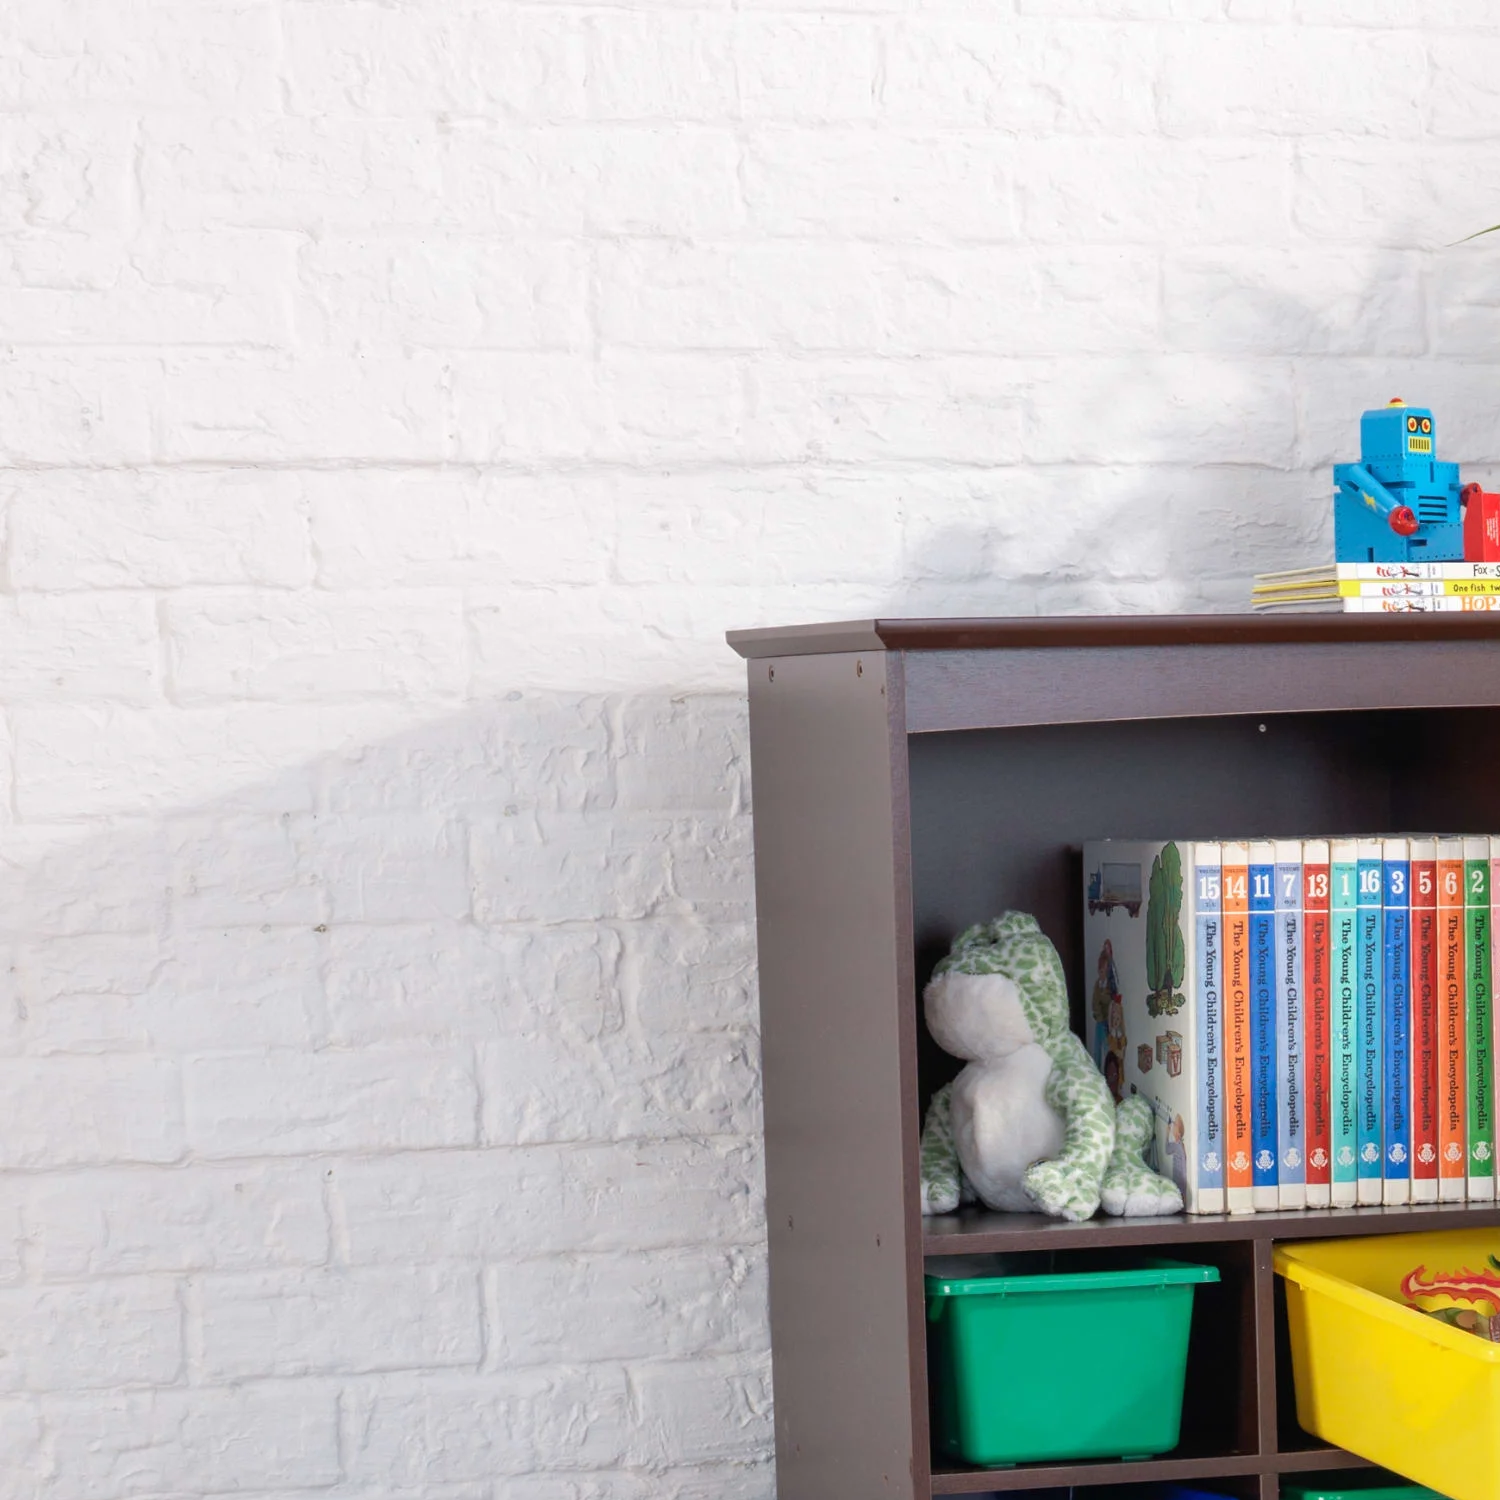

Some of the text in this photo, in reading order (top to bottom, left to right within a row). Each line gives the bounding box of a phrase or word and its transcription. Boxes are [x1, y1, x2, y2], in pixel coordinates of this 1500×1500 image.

[1473, 564, 1488, 576] Fox
[1453, 584, 1468, 592] One
[1470, 583, 1486, 592] fish
[1460, 595, 1497, 611] HOP
[1199, 877, 1220, 900] 15
[1225, 876, 1247, 899] 14
[1254, 874, 1271, 898] 11
[1282, 874, 1296, 897] 7
[1308, 874, 1328, 898] 13
[1341, 873, 1350, 896] 1
[1360, 869, 1380, 893] 16
[1391, 870, 1404, 894] 3
[1419, 871, 1432, 894] 5
[1445, 872, 1457, 895] 6
[1472, 870, 1484, 893] 2
[1315, 919, 1325, 943] The
[1313, 947, 1325, 984] Young
[1205, 922, 1219, 1140] The Young Children's Encyclopedia
[1232, 922, 1247, 1140] The Young Children's Encyclopedia
[1285, 920, 1300, 1137] The Young Children's Encyclopedia
[1341, 919, 1353, 1136] The Young Children's Encyclopedia
[1364, 915, 1377, 1131] The Young Children's Encyclopedia
[1446, 917, 1460, 1131] The Young Children's Encyclopedia
[1473, 916, 1488, 1130] The Young Children's Encyclopedia
[1314, 1053, 1326, 1136] Encyclopedia
